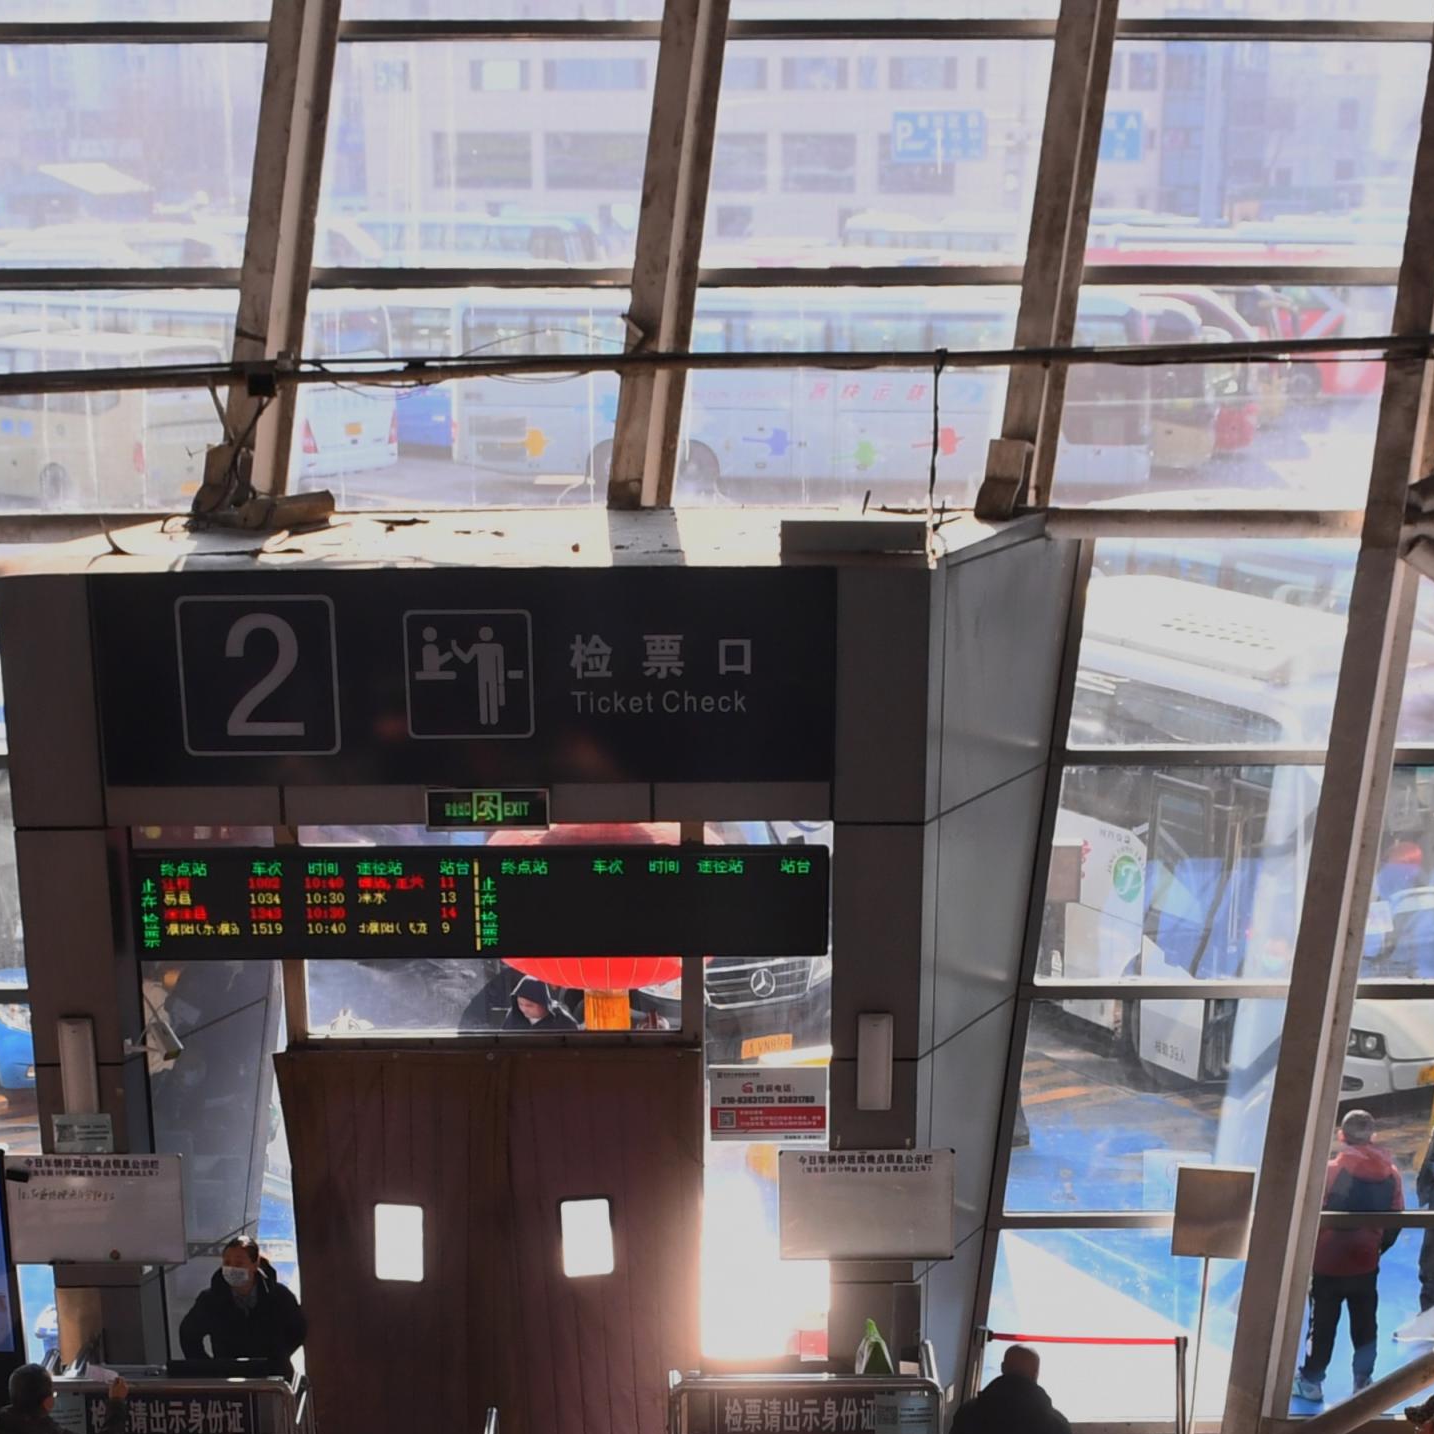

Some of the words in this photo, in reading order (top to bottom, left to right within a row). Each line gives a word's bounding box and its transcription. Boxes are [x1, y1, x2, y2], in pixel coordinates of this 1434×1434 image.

[570, 634, 752, 679] 检票口
[225, 612, 306, 736] 2
[570, 689, 653, 713] Ticket
[662, 689, 747, 713] Check
[503, 801, 529, 816] EXIT
[160, 861, 207, 877] 终点站
[252, 861, 283, 876] 车次
[307, 861, 339, 876] 时间
[439, 861, 470, 876] 站台
[501, 859, 548, 875] 终点站
[592, 859, 625, 874] 车次
[648, 859, 680, 874] 时间
[780, 858, 811, 873] 站台
[439, 876, 455, 889] 11
[249, 892, 281, 905] 1034
[305, 892, 345, 905] 10:30
[440, 890, 457, 904] 13
[440, 905, 457, 919] 14
[251, 922, 283, 936] 1519
[307, 922, 347, 936] 10:40
[442, 921, 451, 935] 9
[798, 1154, 933, 1166] 今日车辆停班或晚点信息公示栏
[90, 1399, 245, 1434] 检请出示身份证
[724, 1397, 876, 1434] 检票请出示身份证
